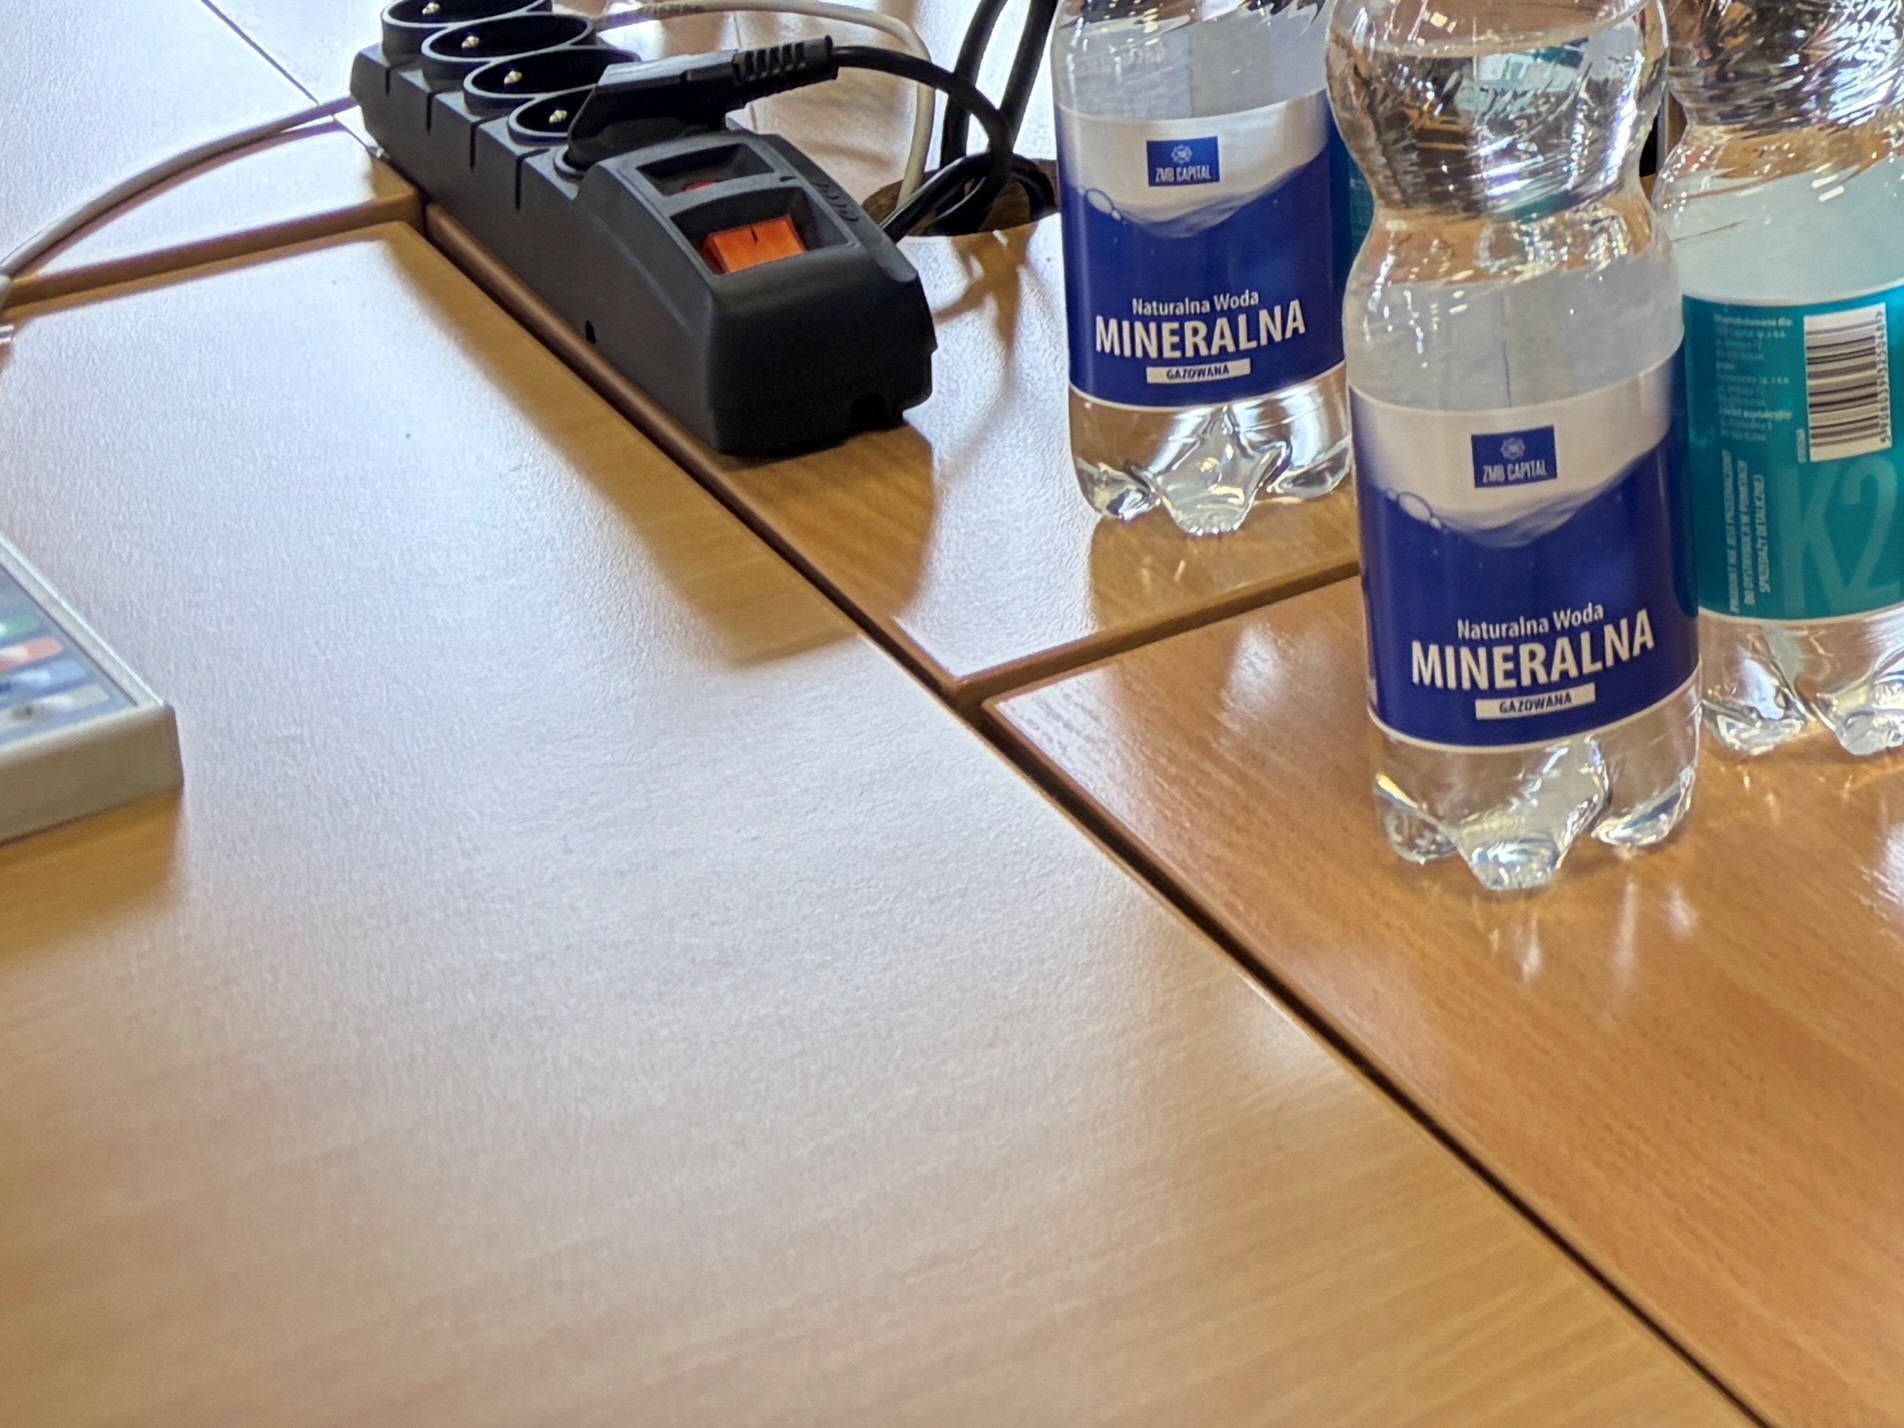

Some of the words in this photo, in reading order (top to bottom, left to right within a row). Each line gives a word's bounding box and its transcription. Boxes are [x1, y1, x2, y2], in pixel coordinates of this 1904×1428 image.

[1176, 165, 1212, 182] CAPITAL
[1132, 297, 1210, 317] Naturalna
[1213, 289, 1259, 312] Woda
[1095, 299, 1307, 360] MINERALNA
[1166, 364, 1230, 380] GAZOWANA
[1482, 464, 1504, 484] ZMB
[1506, 460, 1548, 482] CAPITAL
[1456, 616, 1550, 641] Naturalna
[1552, 602, 1604, 630] Woda
[1411, 608, 1655, 691] MINERALNA
[1498, 692, 1573, 714] GAZOWANA
